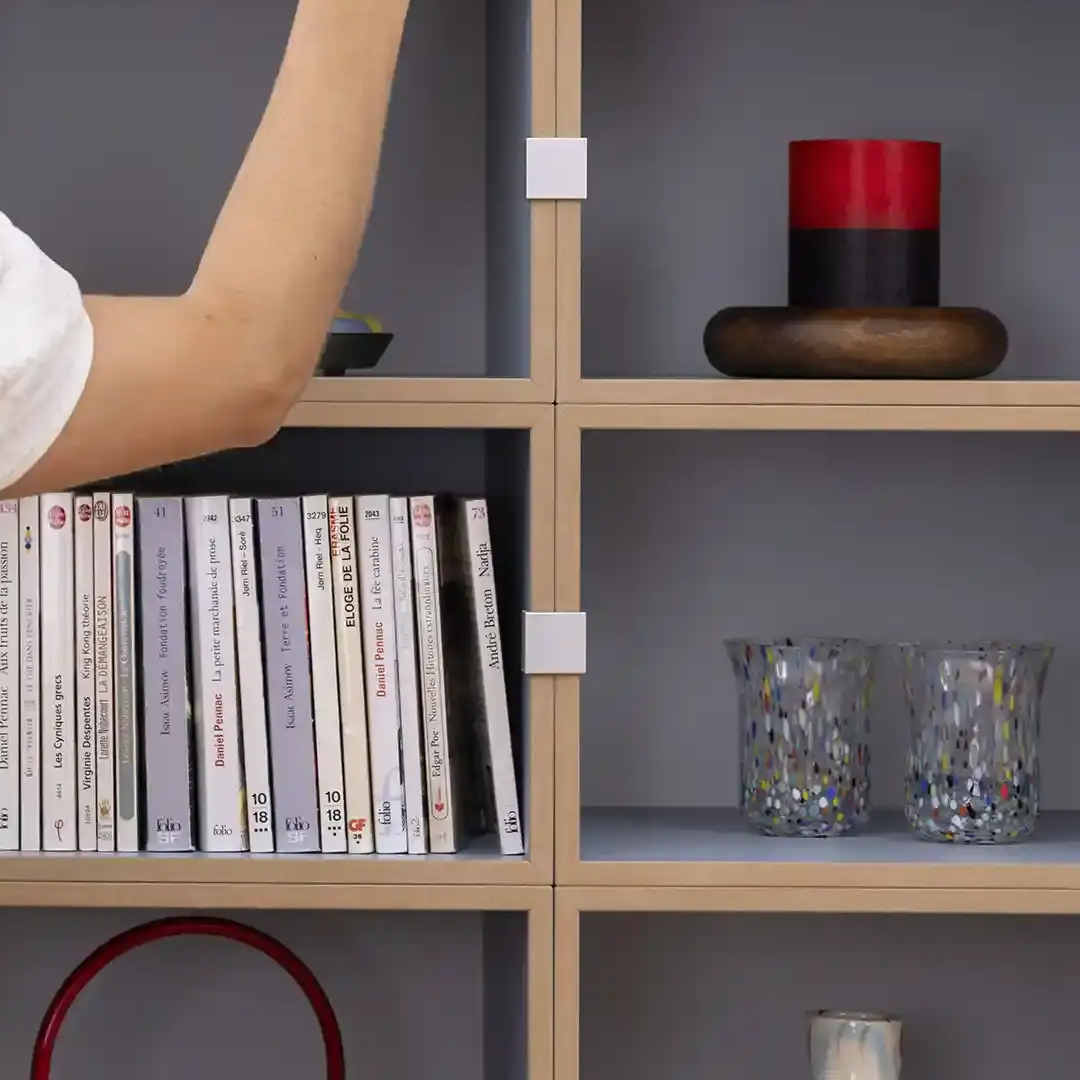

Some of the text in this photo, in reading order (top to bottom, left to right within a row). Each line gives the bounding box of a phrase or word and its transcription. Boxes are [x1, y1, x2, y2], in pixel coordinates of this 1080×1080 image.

[154, 507, 166, 518] 41
[306, 511, 327, 520] 3279
[365, 510, 380, 518] 2043
[240, 560, 249, 576] Riel
[314, 527, 324, 570] Riel Heq
[338, 506, 356, 628] ELOGE DE LA FOLIE
[368, 536, 382, 610] La fée carabine
[476, 542, 492, 577] Nadja
[156, 546, 169, 659] Fondation foudroyée
[206, 538, 225, 682] La petite marchande de prose
[276, 545, 293, 652] Terre et Fondation
[81, 594, 92, 679] King Kong théorie
[94, 596, 108, 694] LA DÉMANGEAISON
[482, 588, 500, 671] André Breton
[374, 622, 386, 698] Daniel Pennac
[53, 674, 64, 769] Les Cyniques grecs
[159, 670, 171, 736] Isaac Asimov
[283, 663, 297, 730] Isaac Asimov
[82, 696, 93, 791] Virginie Despentes
[212, 692, 225, 767] Daniel Pennac
[432, 751, 443, 777] Edgar
[251, 793, 267, 805] 10
[253, 811, 268, 823] 18
[324, 791, 341, 803] 10
[326, 809, 342, 822] 18
[378, 800, 392, 825] folio
[212, 824, 233, 836] folio
[348, 818, 367, 832] GF
